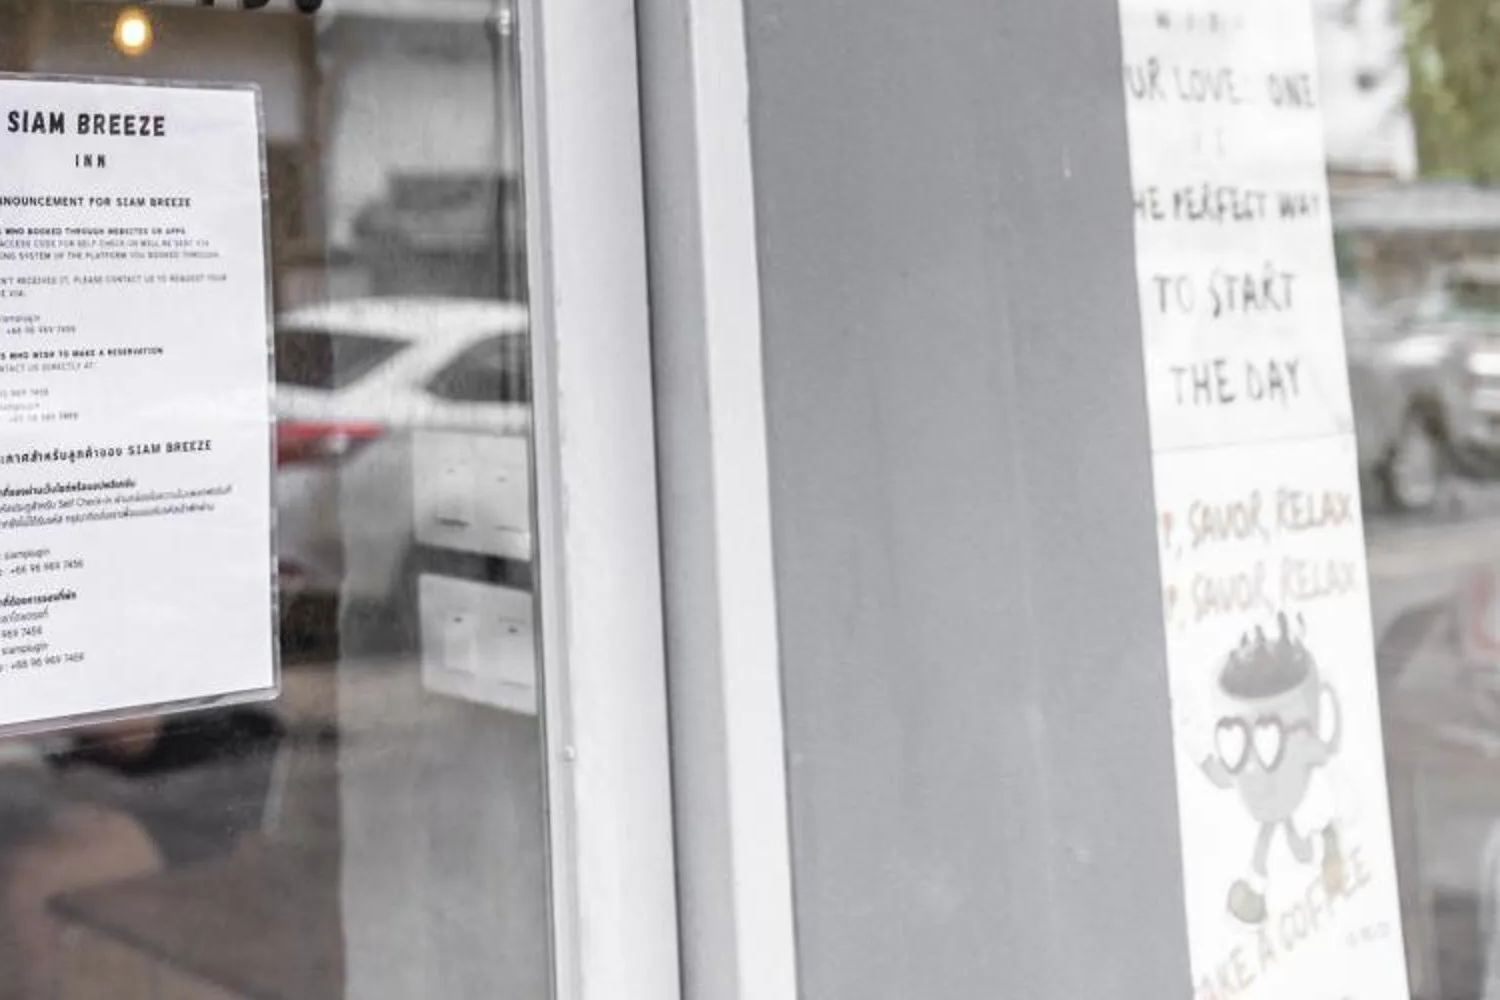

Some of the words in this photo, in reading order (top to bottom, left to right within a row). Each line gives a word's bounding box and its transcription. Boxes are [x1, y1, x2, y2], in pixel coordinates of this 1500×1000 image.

[7, 110, 65, 135] SIAM
[77, 113, 166, 138] BREEZE
[75, 154, 106, 169] INN
[89, 197, 111, 208] FOR
[116, 197, 146, 208] SIAM
[149, 197, 191, 208] BREEZE
[1152, 272, 1195, 313] TO
[1207, 260, 1297, 319] START
[1168, 357, 1236, 407] THE
[1246, 356, 1300, 409] DAY
[127, 443, 161, 456] SIAM
[165, 439, 212, 454] BREEZE
